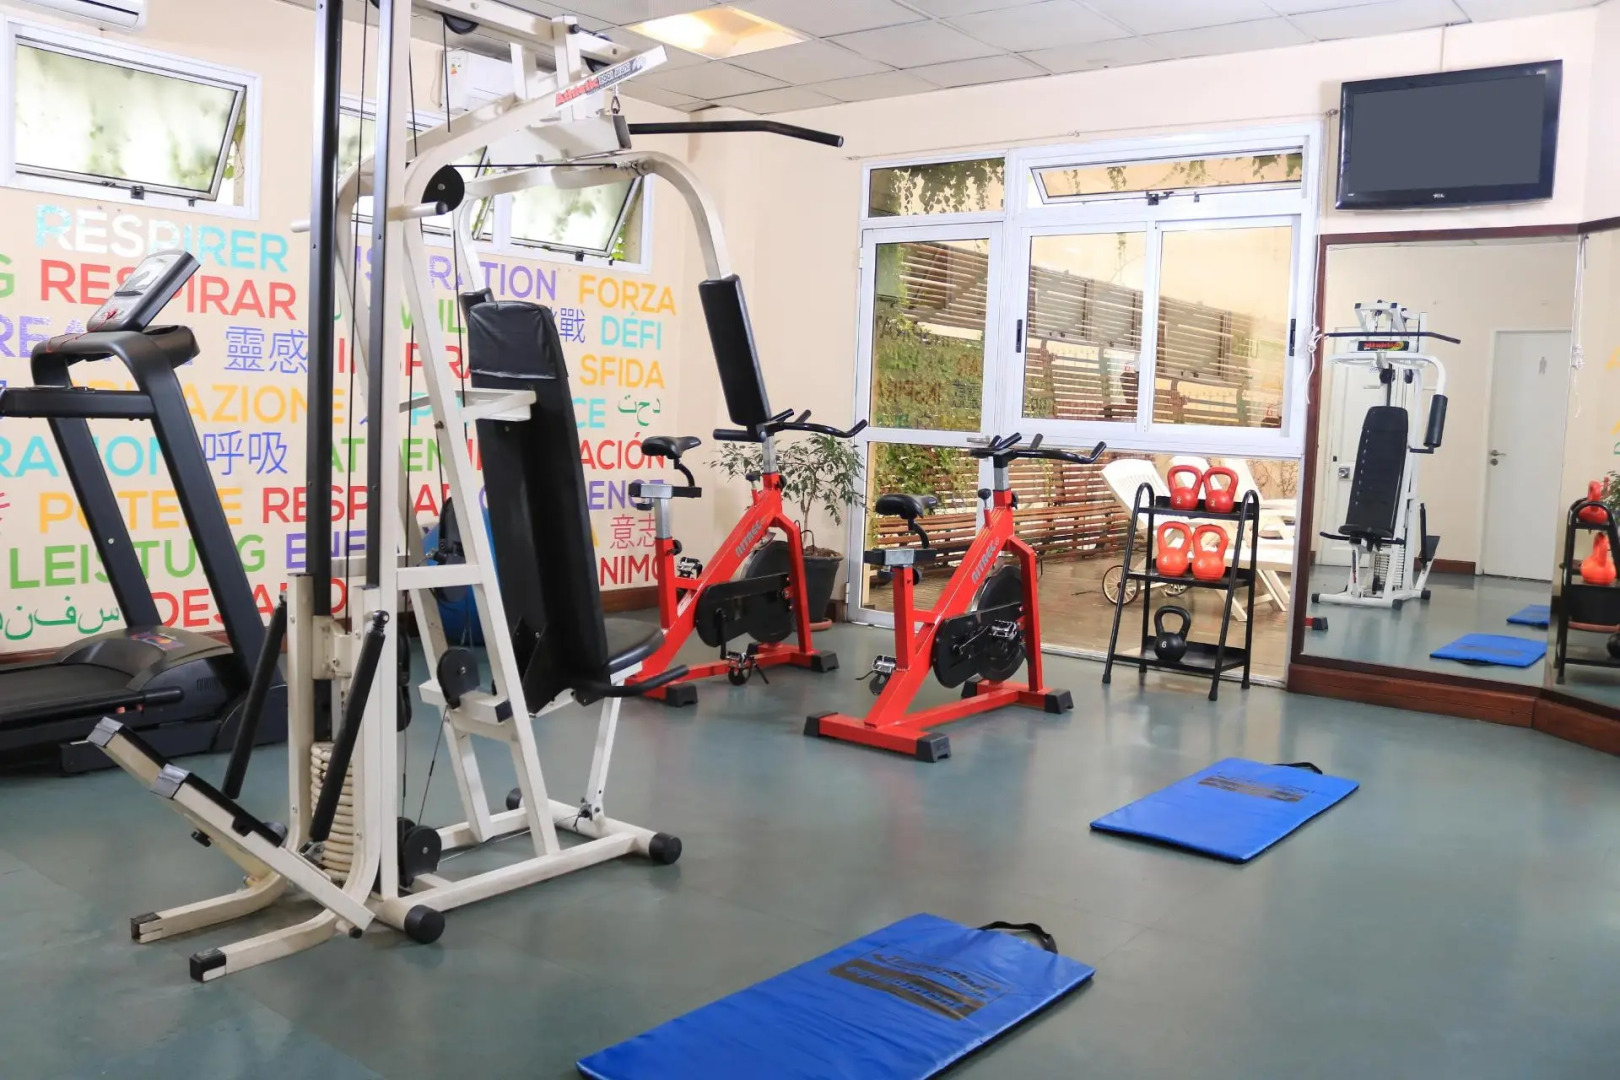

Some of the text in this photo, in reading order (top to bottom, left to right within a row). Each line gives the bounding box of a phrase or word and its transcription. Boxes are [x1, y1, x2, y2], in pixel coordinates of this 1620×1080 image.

[35, 204, 289, 273] RESPIRER
[40, 259, 297, 321] REIRAR
[578, 274, 677, 316] FORZA
[550, 307, 586, 343] 戰
[601, 311, 662, 351] DÉFI
[224, 325, 308, 375] 靈感
[579, 353, 665, 389] SFIDA
[203, 430, 288, 476] 呼吸
[39, 487, 243, 534] PTEE
[9, 534, 266, 590] LEITUG
[1161, 640, 1167, 648] 6
